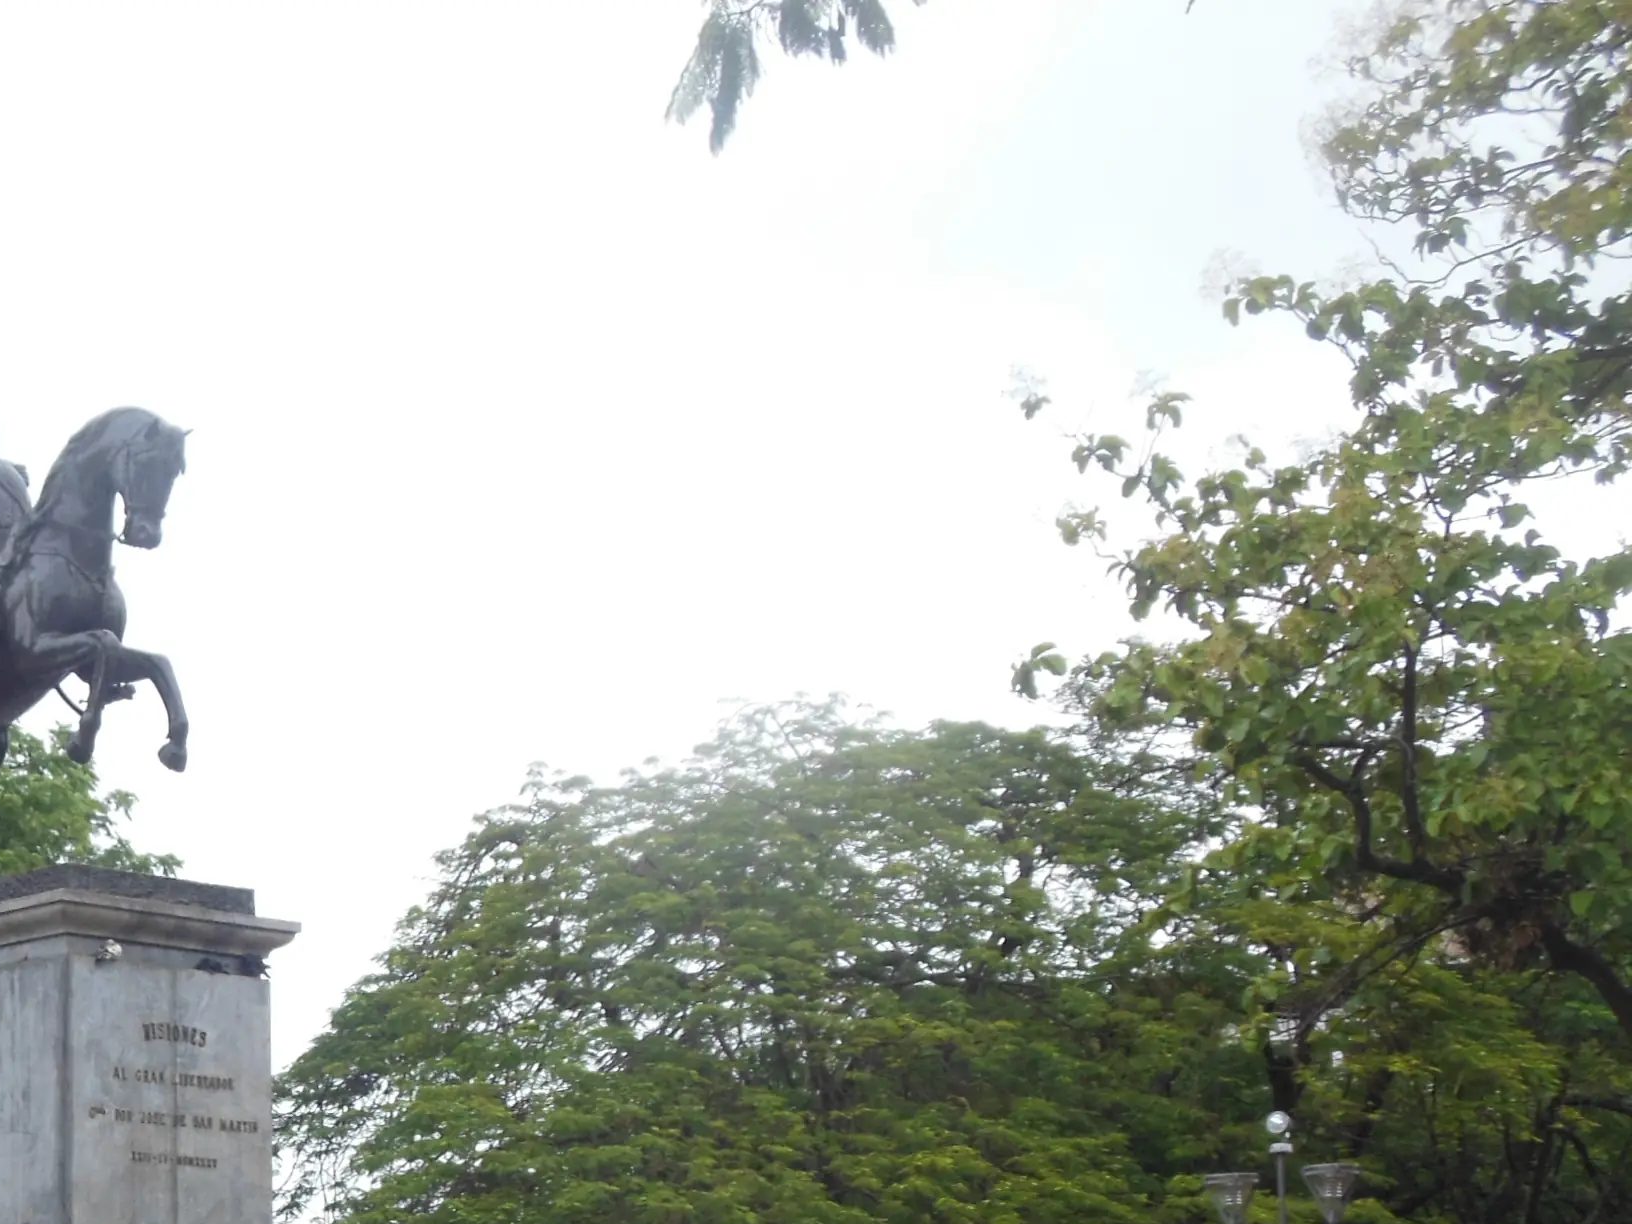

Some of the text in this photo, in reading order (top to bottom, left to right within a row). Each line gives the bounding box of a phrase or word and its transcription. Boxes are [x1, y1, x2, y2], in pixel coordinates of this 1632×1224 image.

[142, 1022, 207, 1047] MISIONES
[113, 1066, 234, 1091] AL GRAN LIBERTADOR
[172, 1114, 187, 1128] DE
[192, 1115, 213, 1130] SAN
